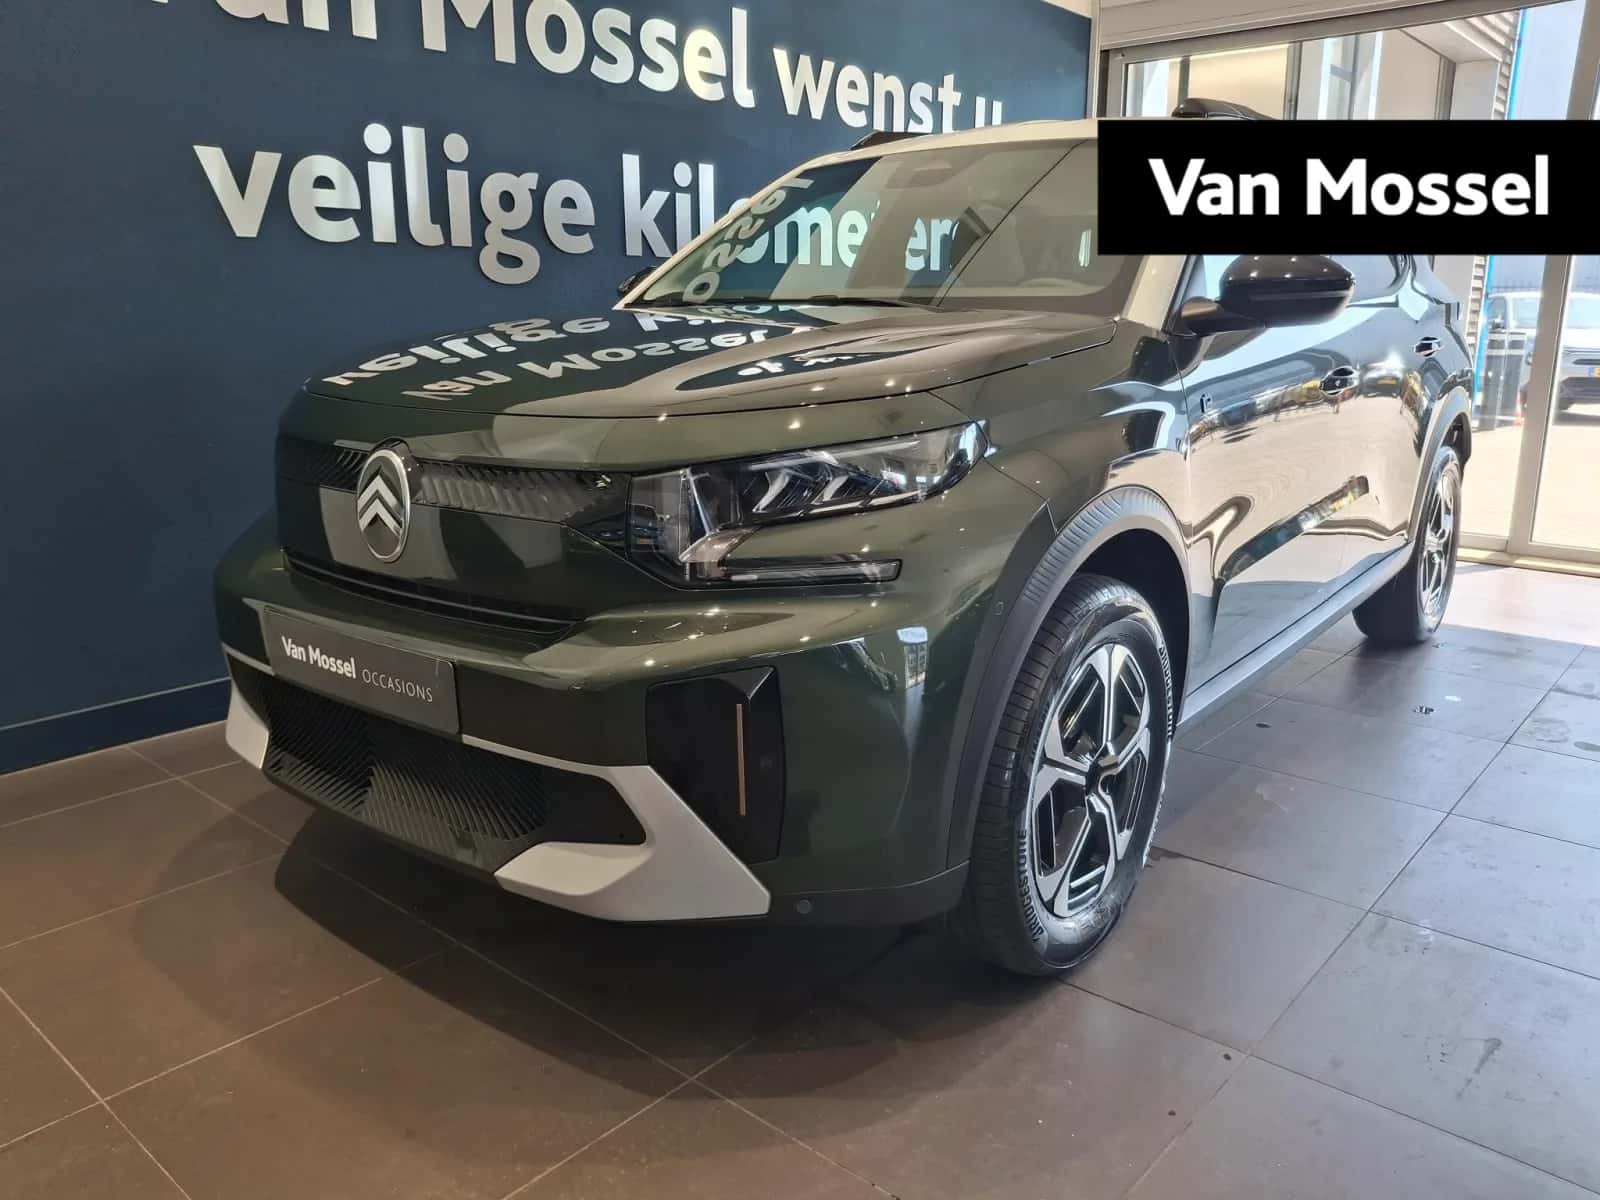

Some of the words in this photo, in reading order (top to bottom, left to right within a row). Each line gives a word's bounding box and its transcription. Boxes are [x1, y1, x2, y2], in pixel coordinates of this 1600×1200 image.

[772, 47, 972, 134] wenst
[192, 122, 596, 285] veilige
[281, 636, 306, 662] Van
[308, 645, 357, 679] Mossel
[361, 669, 433, 702] OCCASIONS
